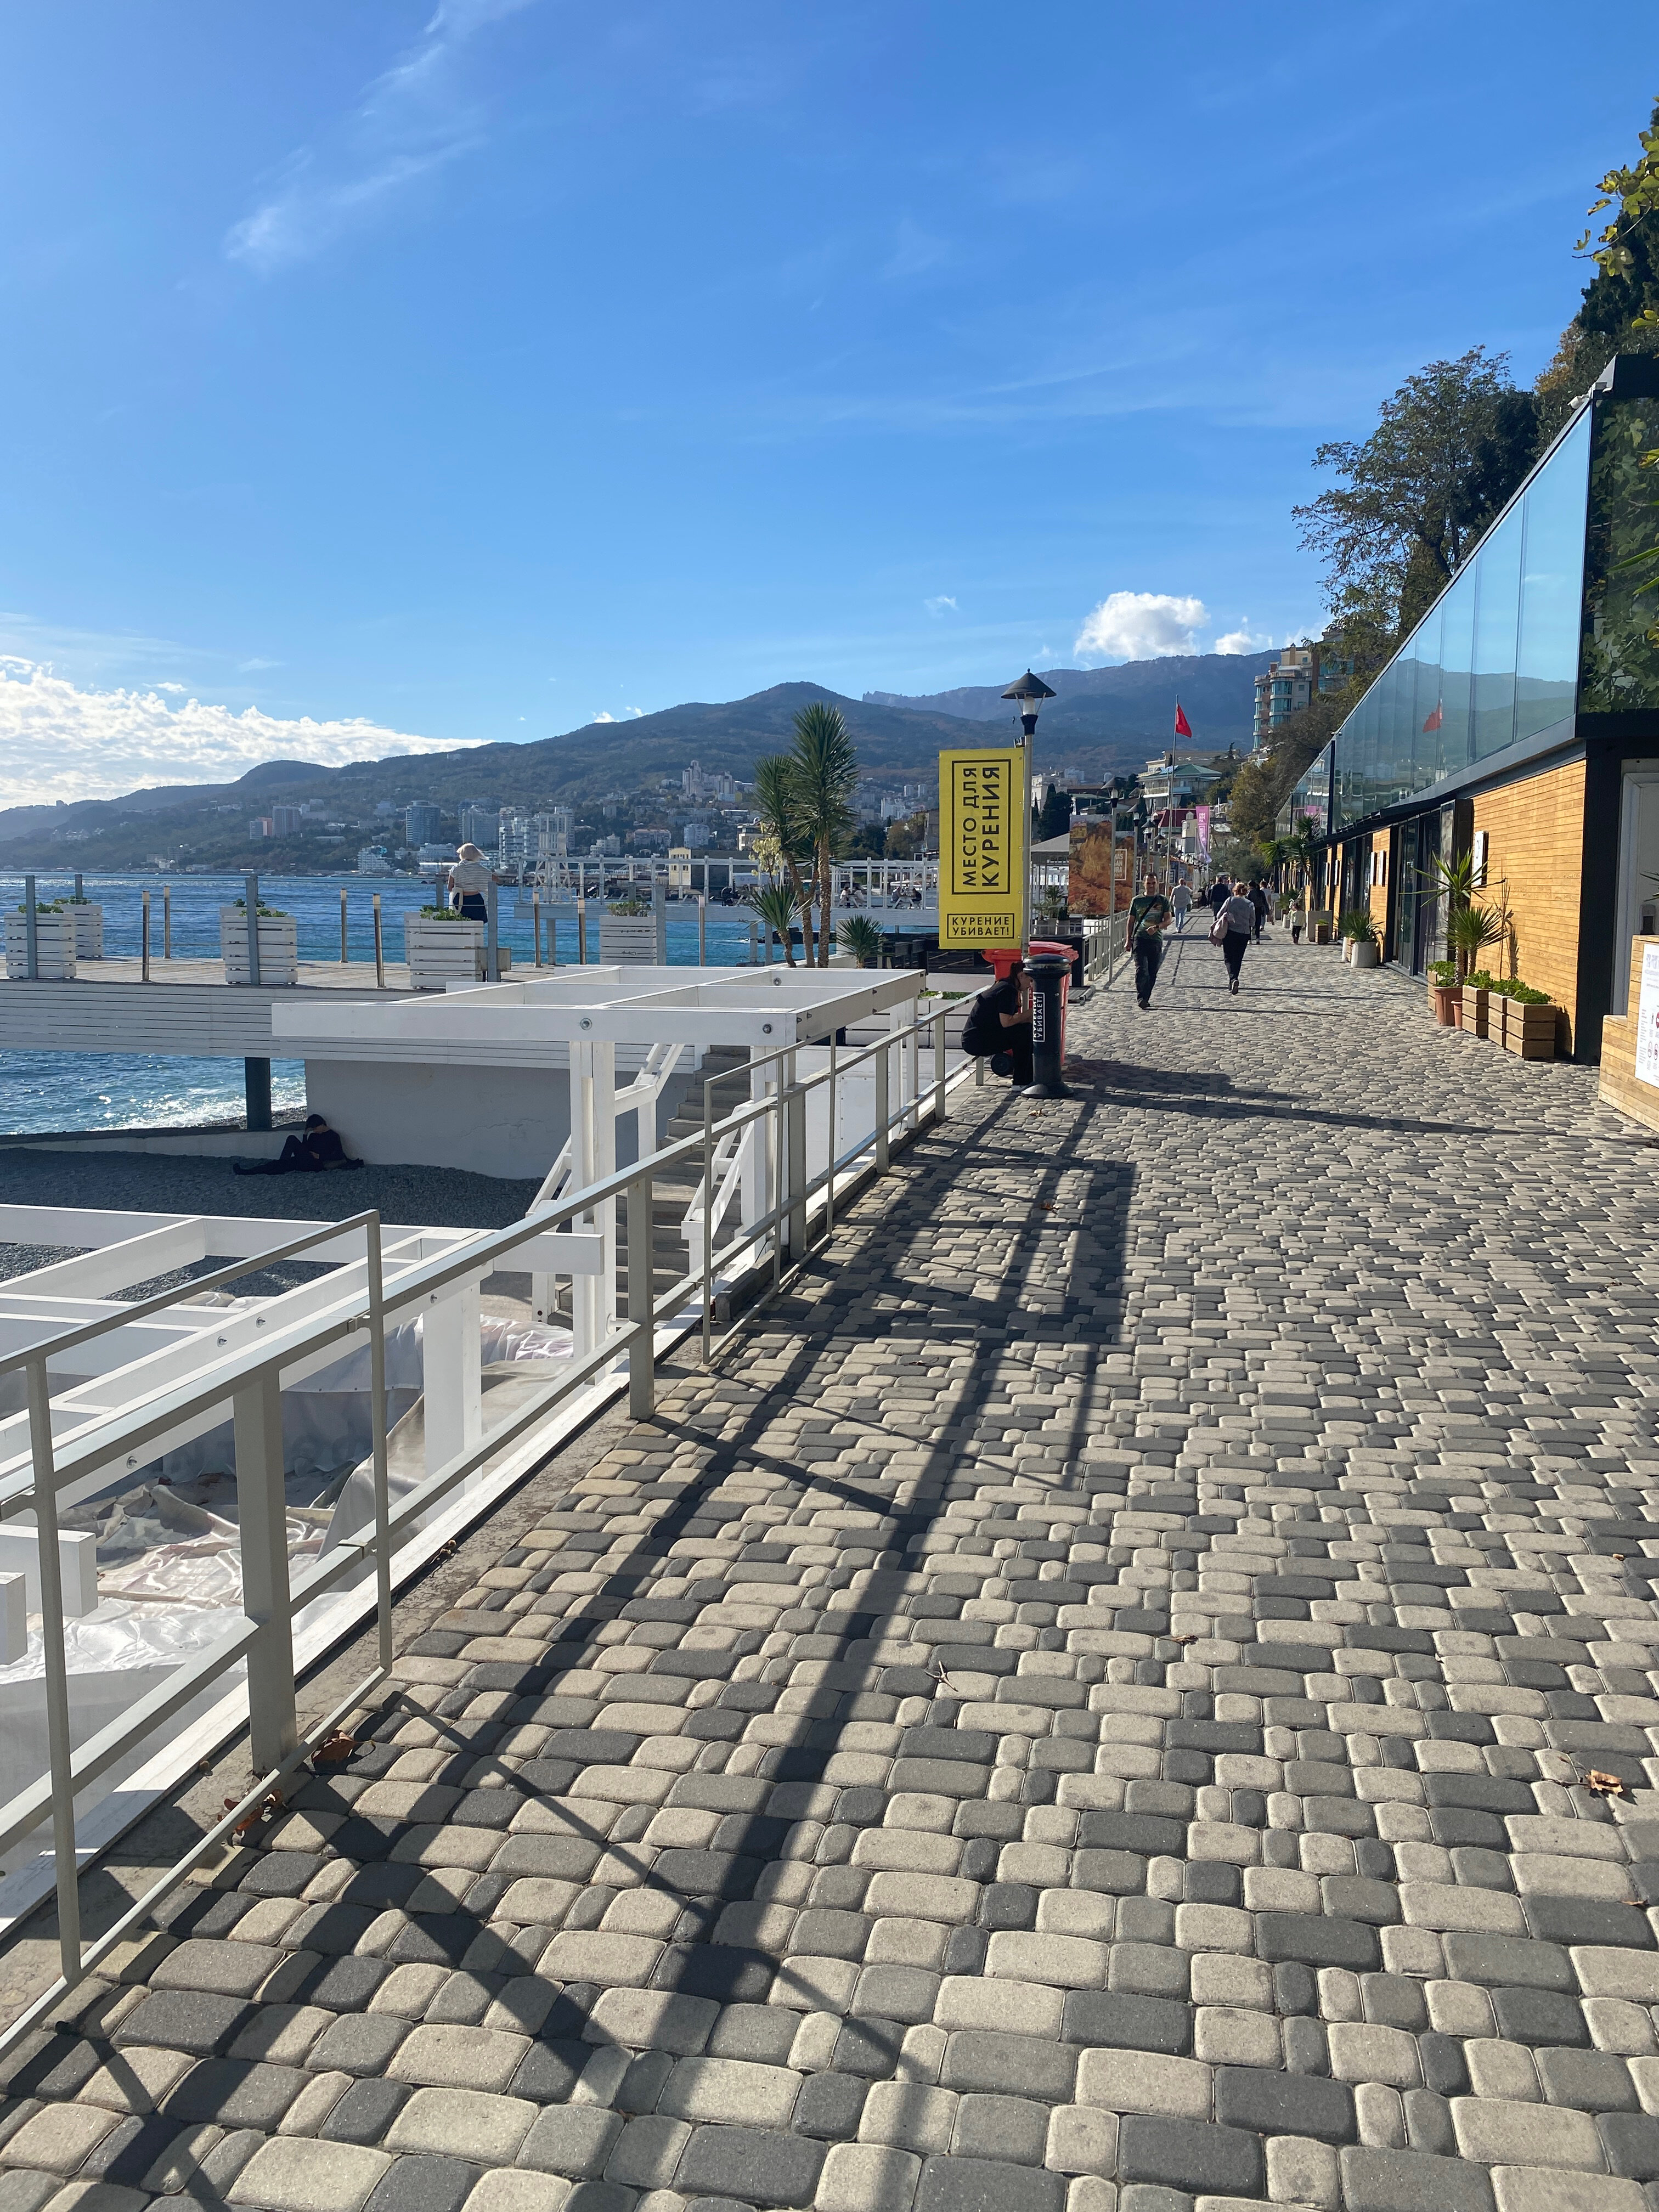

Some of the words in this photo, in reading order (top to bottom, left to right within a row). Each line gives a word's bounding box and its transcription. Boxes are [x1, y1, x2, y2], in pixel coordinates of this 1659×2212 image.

[963, 768, 979, 808] ДЛЯ
[982, 767, 1000, 887] КУРЕНИЯ
[963, 817, 977, 886] МЕСТО
[952, 917, 1009, 926] КУРЕНИЕ
[952, 927, 1009, 935] УБИВАЕТ!
